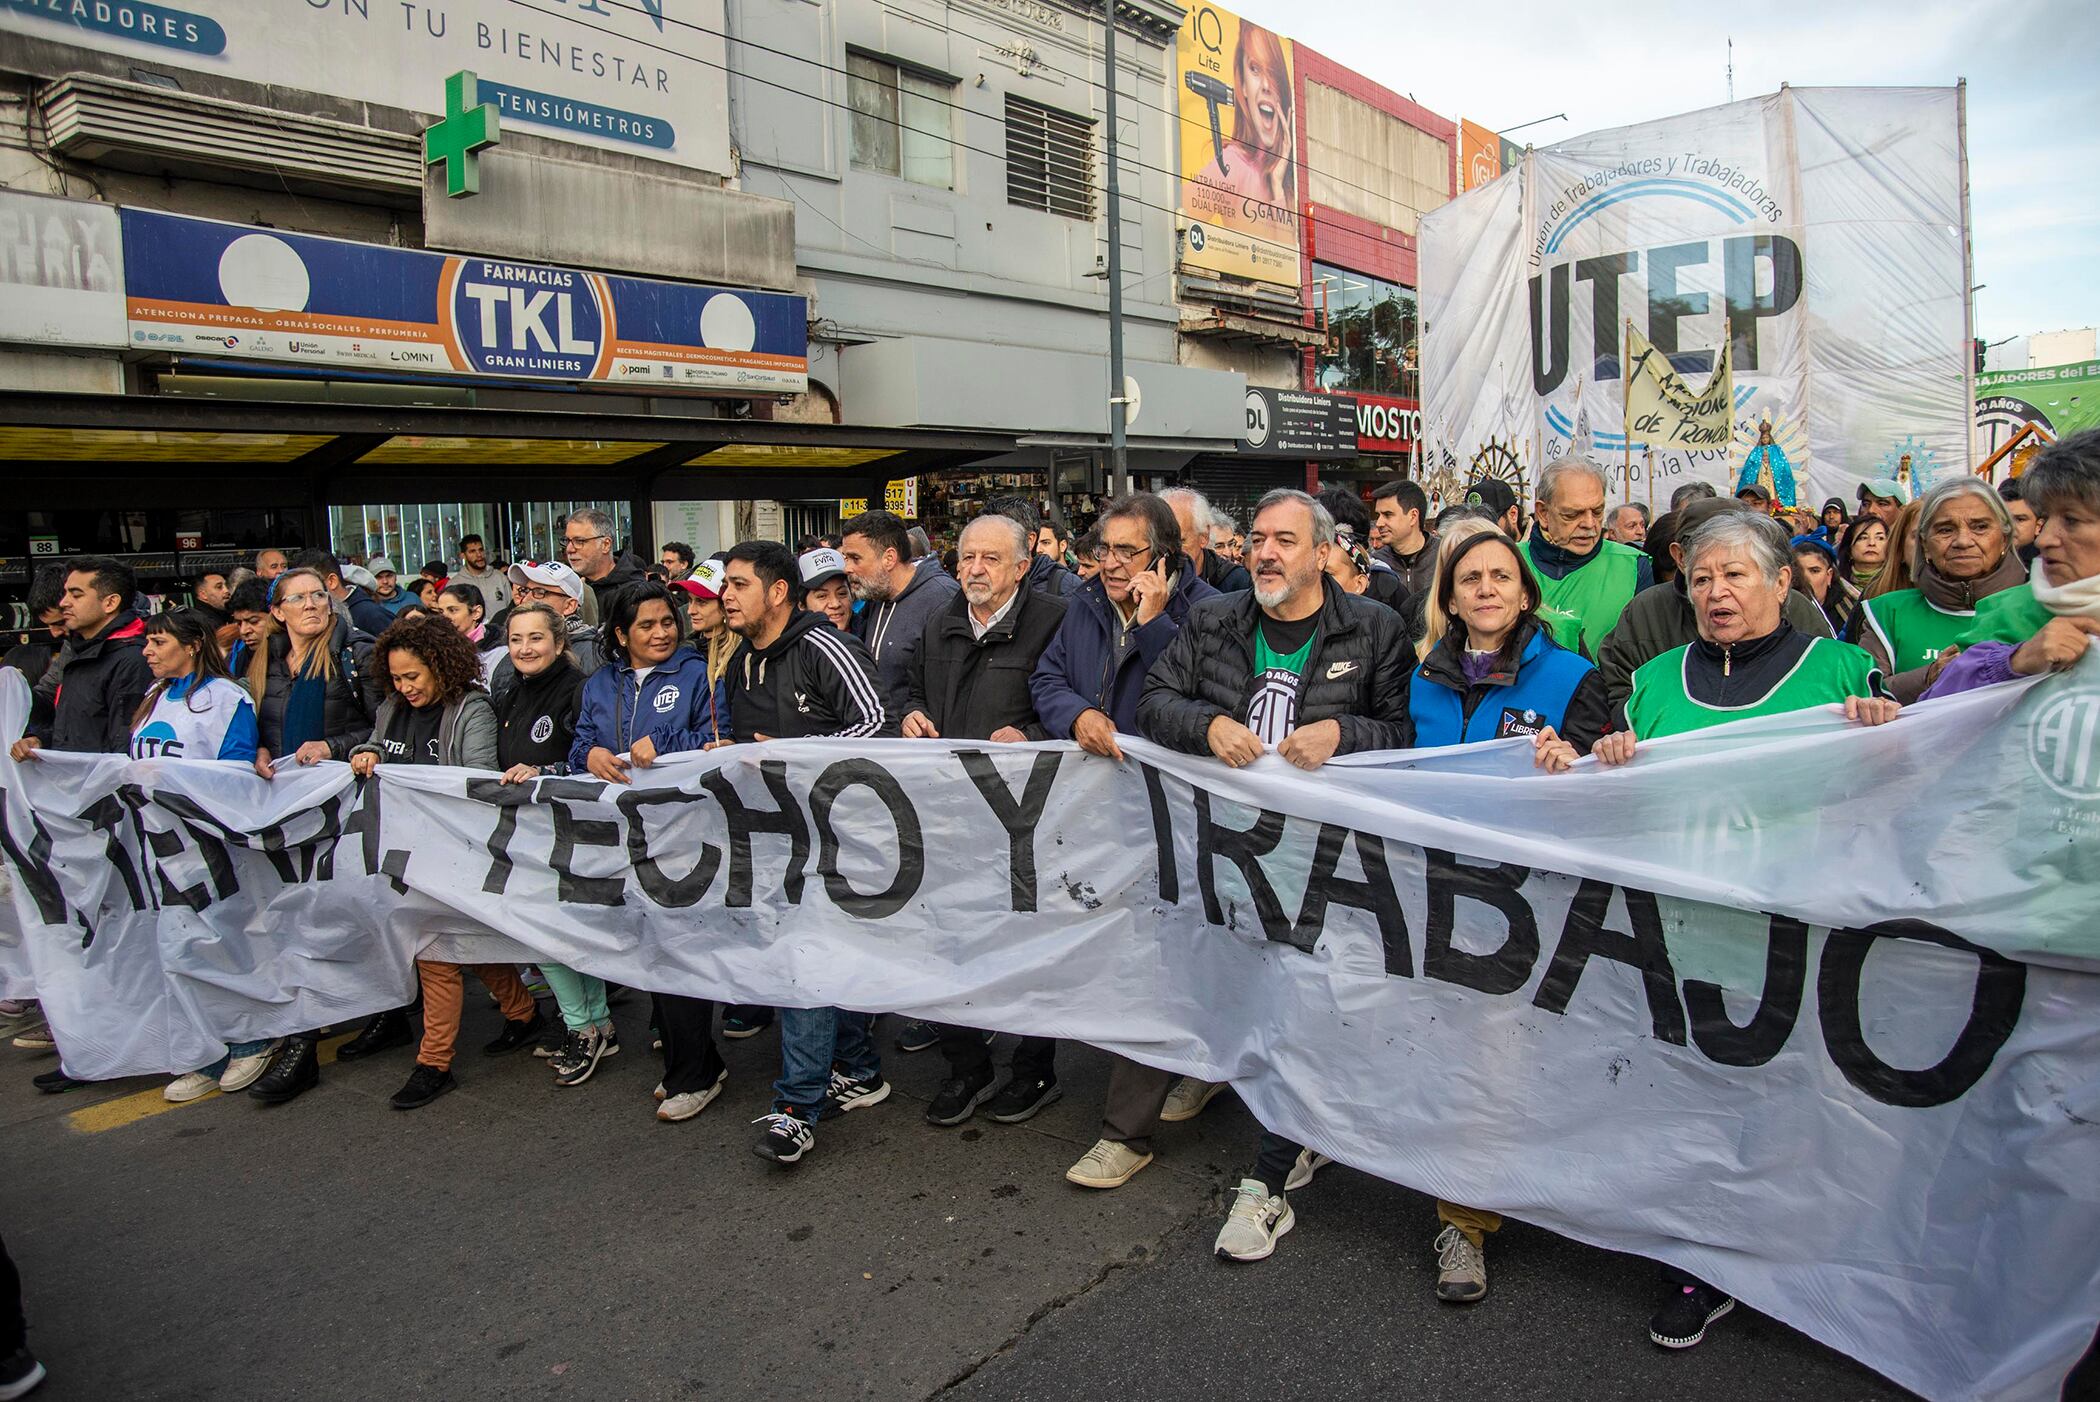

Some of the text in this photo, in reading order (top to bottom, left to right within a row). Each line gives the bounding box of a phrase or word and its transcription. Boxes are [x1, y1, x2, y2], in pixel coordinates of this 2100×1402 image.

[1192, 5, 1222, 55] iQ
[401, 2, 446, 38] TU
[478, 22, 669, 93] BIENESTAR
[1198, 53, 1221, 73] Lite
[497, 91, 654, 139] TENSIÓMETROS
[1551, 200, 1566, 221] de
[1564, 156, 1661, 202] Trabajadores
[1667, 156, 1677, 175] y
[1683, 152, 1783, 223] Trabajadoras
[1191, 197, 1236, 219] DUAL FILTER
[484, 264, 573, 287] FARMACIAS
[135, 307, 196, 319] ATENCION
[208, 313, 264, 325] PREPAGAS
[275, 319, 310, 329] OBRAS
[312, 322, 361, 333] SOCIALES
[465, 282, 595, 356] TKL
[1528, 235, 1803, 397] UTEP
[485, 354, 581, 371] GRAN LINIERS
[628, 365, 650, 375] pami
[2060, 366, 2082, 379] del
[1989, 397, 2024, 413] AÑOS
[36, 542, 53, 552] 88
[182, 538, 197, 548] 96
[1331, 661, 1352, 671] NIKE
[1273, 670, 1299, 687] AÑOS
[653, 690, 680, 707] UTEP
[466, 757, 924, 919] TECHO
[949, 747, 1063, 912] Y
